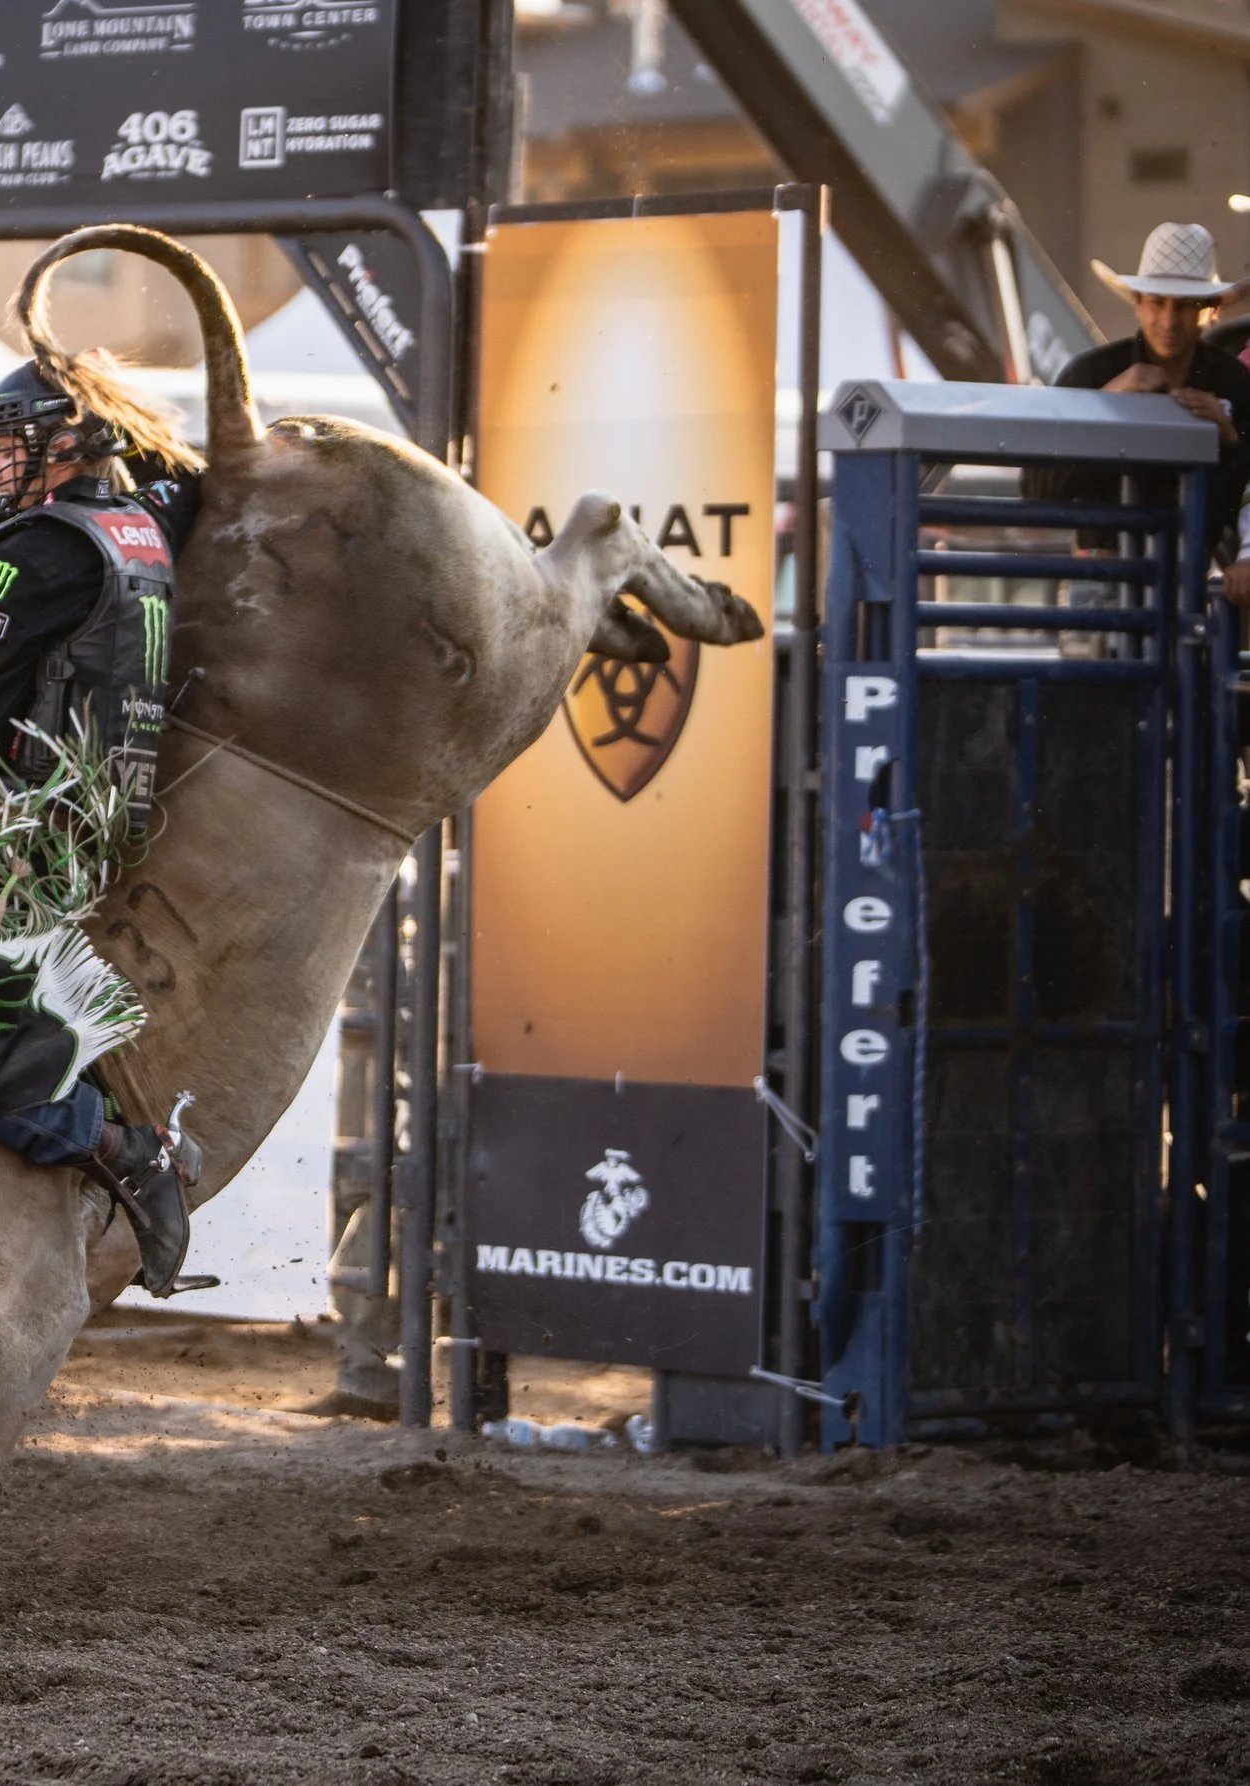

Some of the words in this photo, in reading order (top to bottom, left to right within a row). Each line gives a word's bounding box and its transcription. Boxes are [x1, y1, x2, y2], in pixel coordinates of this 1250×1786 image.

[40, 20, 91, 48] LONE
[93, 12, 197, 38] MOUNTAIN
[242, 13, 297, 30] TOWN
[301, 8, 380, 27] CENTER
[63, 41, 101, 57] LAND
[102, 36, 170, 54] COMPANY
[117, 109, 199, 144] 406
[286, 116, 327, 133] ZERO
[329, 113, 382, 131] SUGAR
[21, 140, 75, 169] PEAKS
[286, 133, 375, 152] HYDRATION
[100, 143, 213, 180] AGAVE
[524, 503, 750, 557] AAT
[476, 1244, 752, 1294] MARINES.COM
